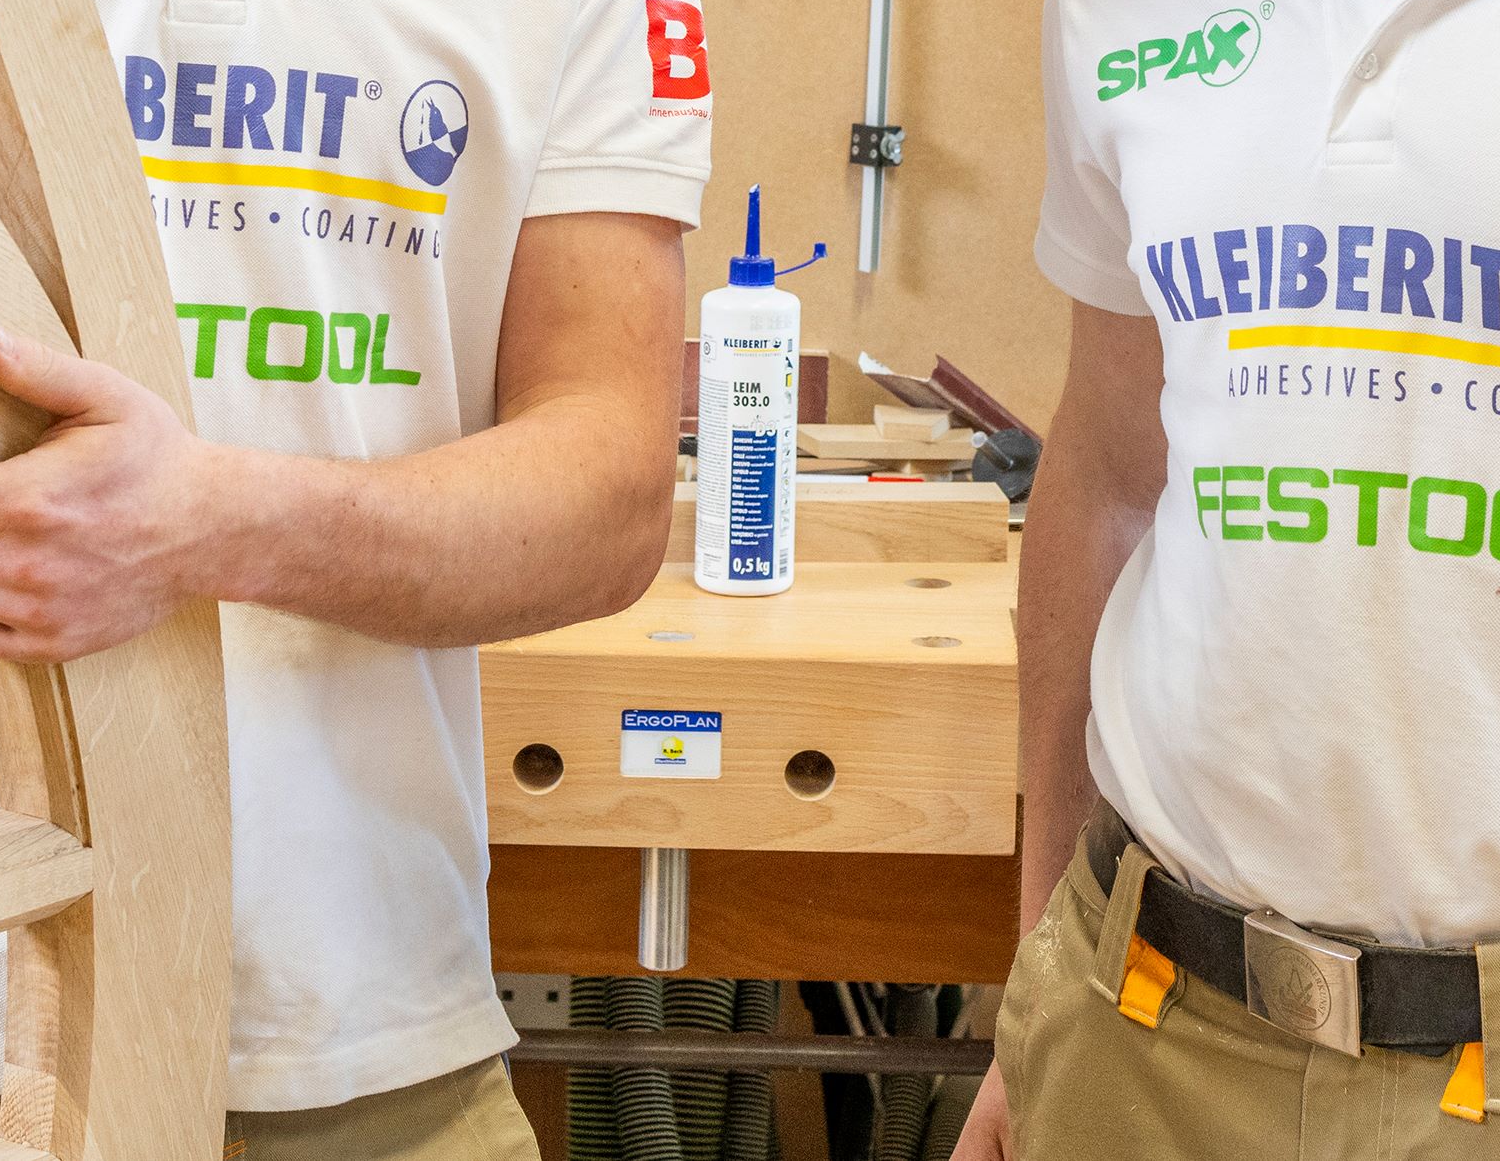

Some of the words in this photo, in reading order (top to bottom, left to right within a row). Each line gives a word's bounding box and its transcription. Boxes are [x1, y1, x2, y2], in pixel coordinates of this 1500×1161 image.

[1097, 20, 1251, 102] SPAX
[649, 105, 708, 119] Innenausbau
[150, 193, 246, 231] SIVES
[302, 206, 442, 259] COATING
[174, 302, 422, 386] TOOL
[723, 337, 768, 349] KLEIBERIT
[733, 381, 761, 393] LEIM
[1228, 365, 1407, 401] ADHESIVES
[733, 395, 770, 407] 303.0
[732, 557, 754, 575] 0,5
[756, 557, 770, 576] kg
